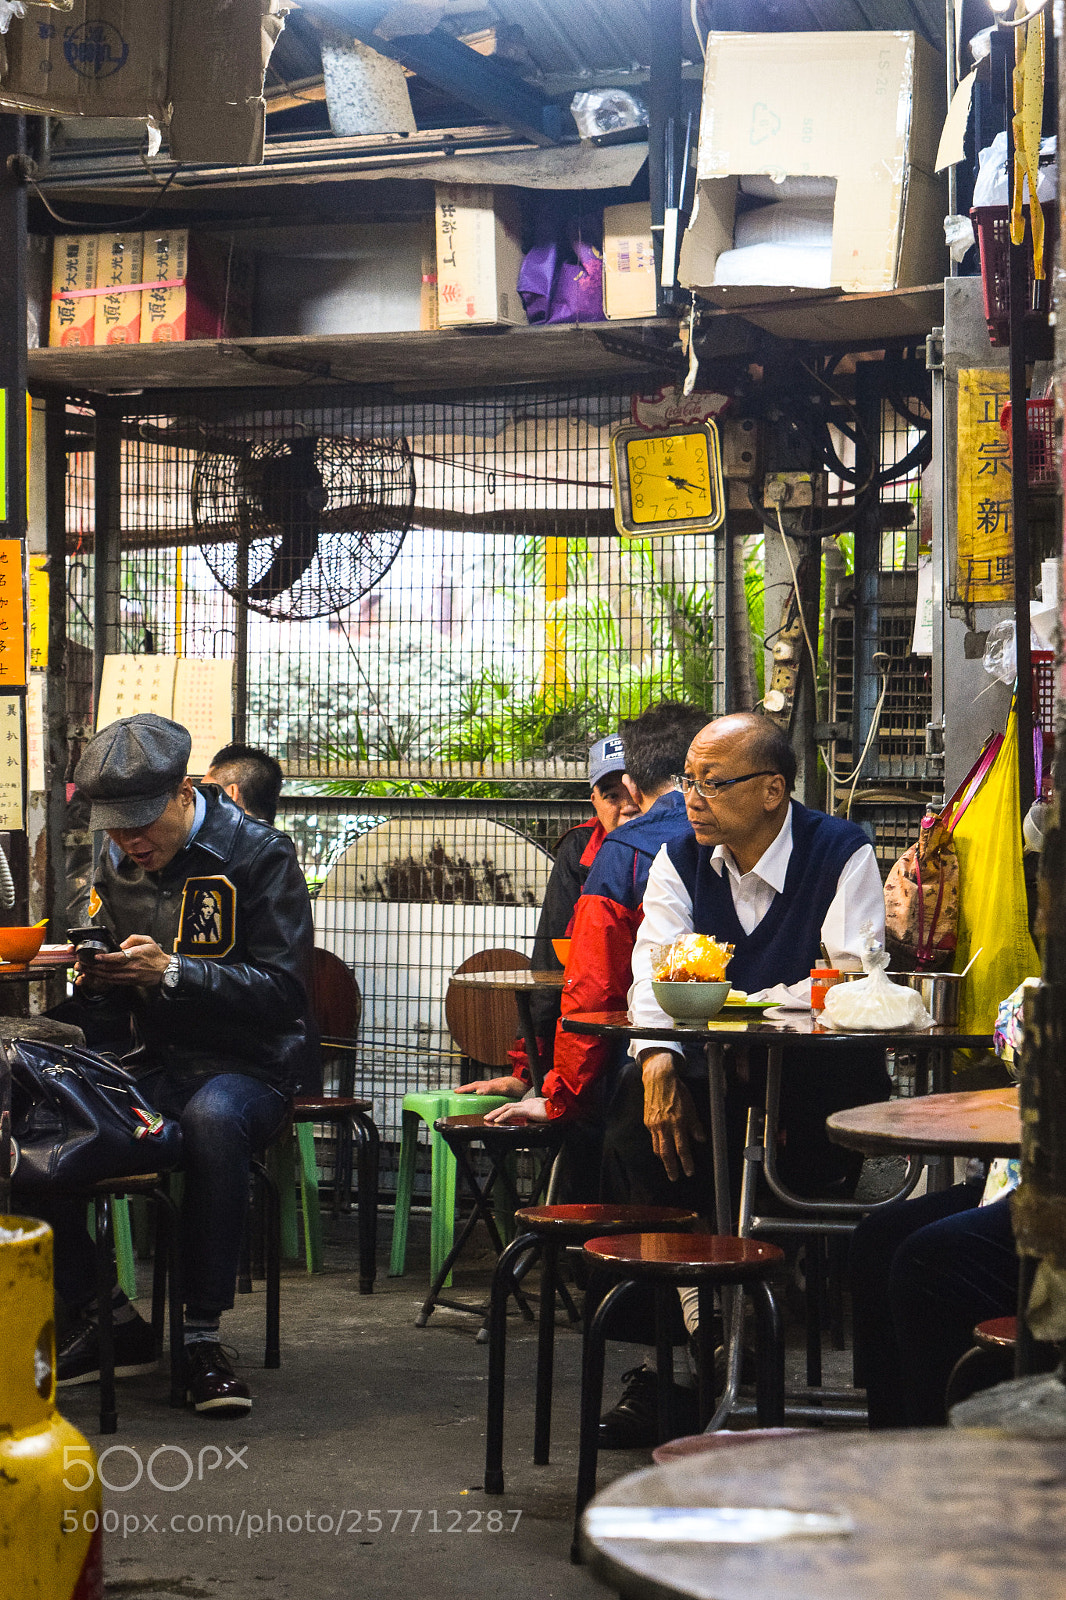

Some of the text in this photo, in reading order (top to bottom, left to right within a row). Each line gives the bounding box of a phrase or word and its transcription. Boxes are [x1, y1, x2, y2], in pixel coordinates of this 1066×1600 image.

[441, 203, 456, 268] 出前一丁
[644, 440, 656, 455] 11
[660, 438, 675, 453] 12
[683, 436, 688, 451] 1
[630, 455, 647, 470] 10
[695, 448, 704, 463] 2
[633, 474, 643, 489] 9
[696, 467, 706, 482] 3
[635, 494, 645, 508] 8
[698, 489, 707, 501] 4
[650, 504, 658, 520] 7
[667, 503, 677, 519] 6
[685, 501, 694, 516] 5
